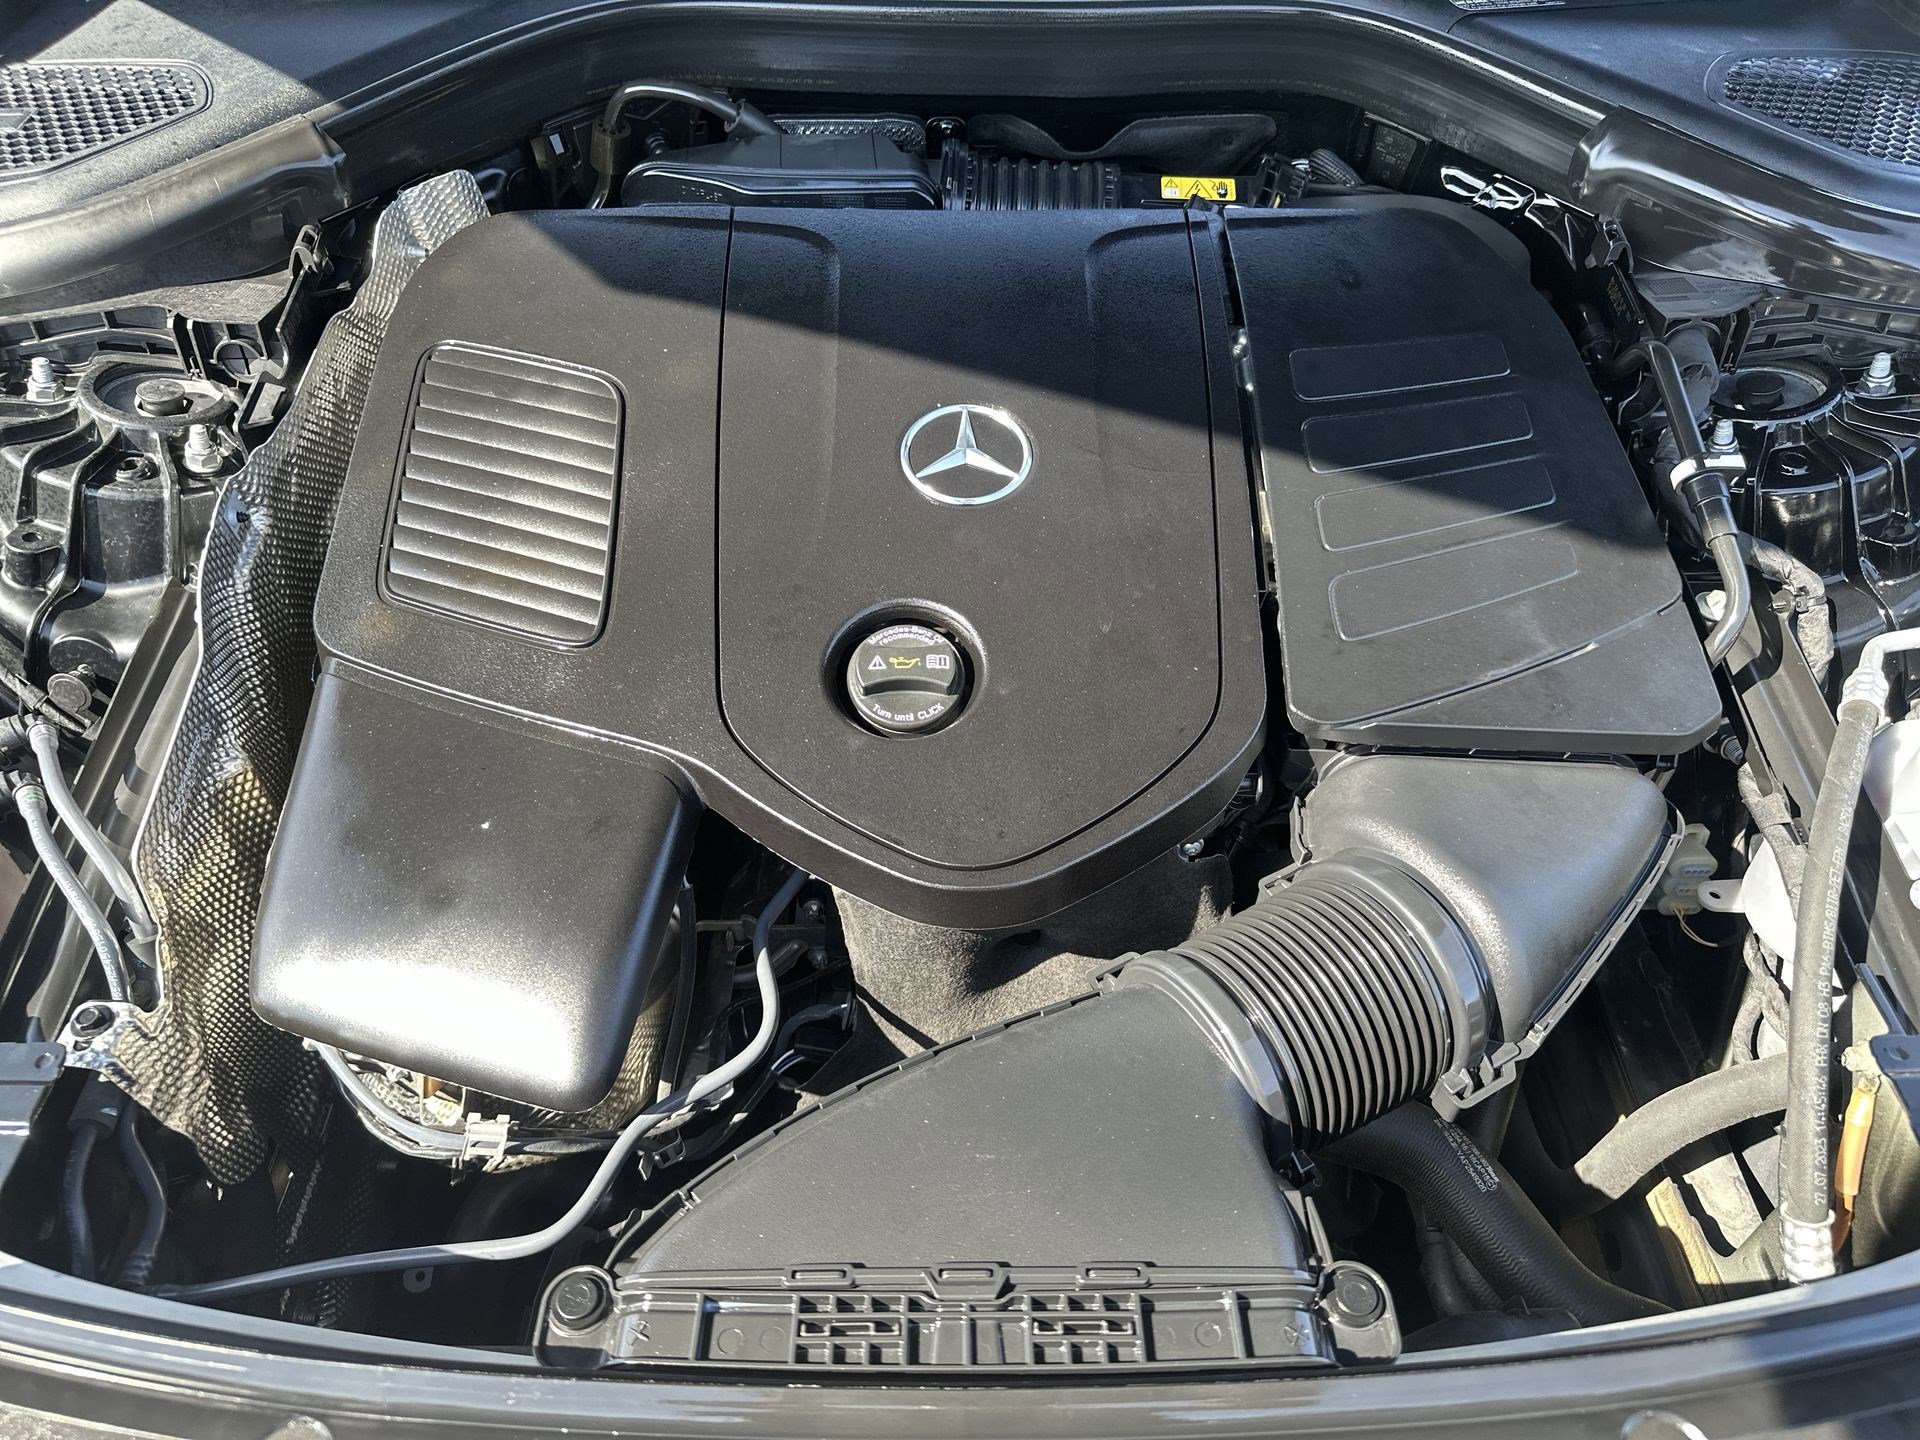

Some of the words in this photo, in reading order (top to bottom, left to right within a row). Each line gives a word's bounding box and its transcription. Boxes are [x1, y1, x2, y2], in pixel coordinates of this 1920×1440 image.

[867, 626, 933, 645] Mercedes-Benz
[879, 633, 935, 646] recommended
[872, 703, 892, 719] Turn
[894, 713, 914, 722] until
[918, 702, 945, 720] CLICK
[1814, 1137, 1828, 1206] 27.07.2023
